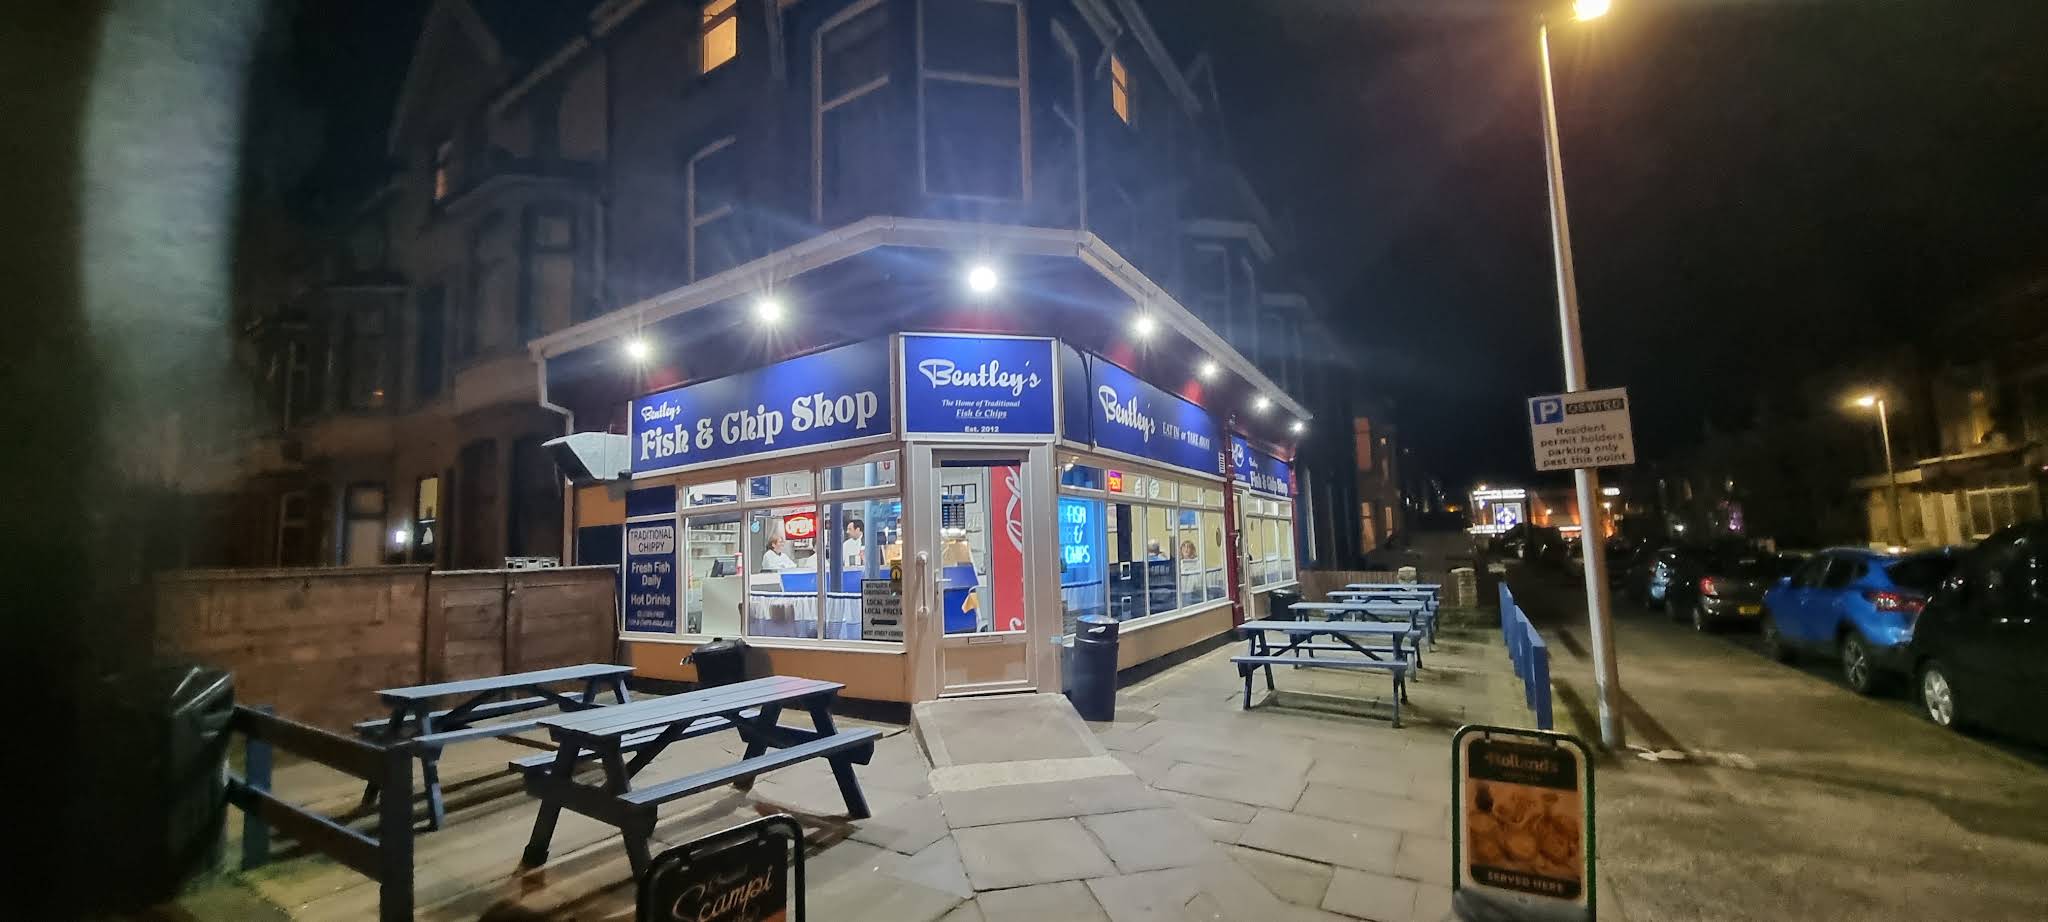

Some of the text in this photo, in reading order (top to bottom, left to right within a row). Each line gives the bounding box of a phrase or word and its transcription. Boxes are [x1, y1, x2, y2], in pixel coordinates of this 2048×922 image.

[919, 358, 1042, 396] Bentley's
[640, 399, 681, 422] Bentley's
[942, 399, 953, 407] The
[976, 400, 983, 408] of
[984, 400, 1021, 408] Traditional
[956, 409, 1007, 420] Fish & Chips
[1098, 384, 1156, 443] Bentley's
[1540, 400, 1559, 422] P
[640, 391, 878, 462] Fish & Chip Shop
[964, 425, 1000, 433] Est. 2012
[1556, 424, 1607, 436] Resident
[1540, 433, 1625, 448] permit holders
[1548, 443, 1619, 457] parking only
[1543, 453, 1626, 468] past this point
[630, 528, 673, 540] TRADITIONAL
[639, 542, 665, 553] CHIPPY
[631, 561, 671, 574] Fresh Fish
[642, 575, 662, 589] Daily
[630, 594, 671, 606] Hot Drinks
